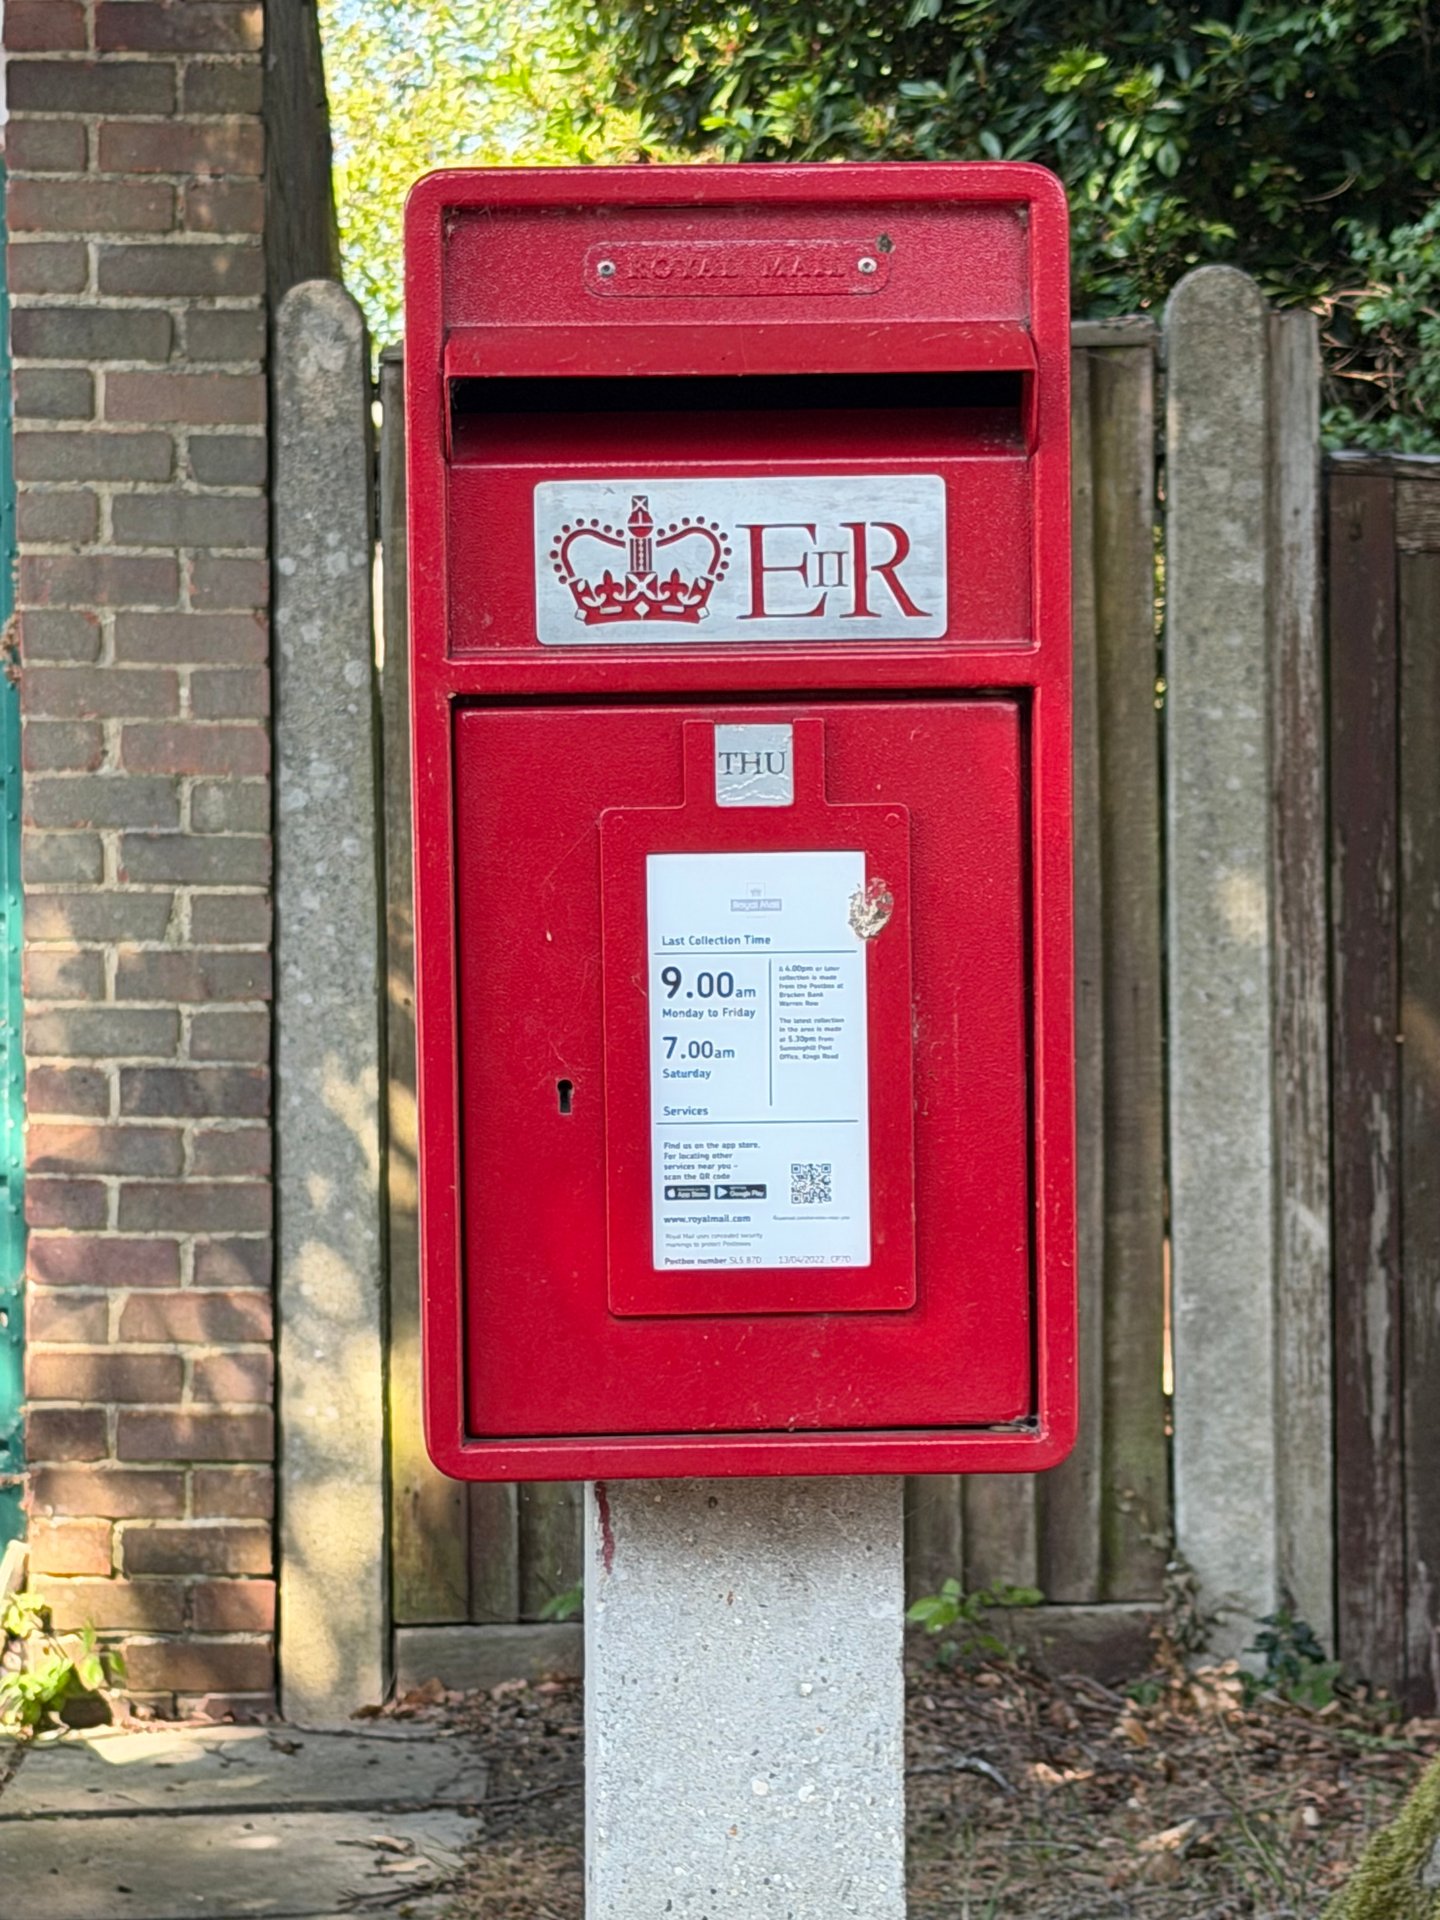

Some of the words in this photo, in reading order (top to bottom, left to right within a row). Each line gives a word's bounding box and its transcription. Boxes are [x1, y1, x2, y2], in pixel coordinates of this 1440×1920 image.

[627, 255, 740, 279] ROYAL
[718, 750, 788, 775] THU
[662, 935, 685, 946] Last
[689, 935, 740, 945] Collection
[744, 934, 771, 944] Time
[662, 1008, 704, 1019] Monday
[708, 1008, 718, 1017] to
[722, 1007, 756, 1019] Friday
[662, 1036, 735, 1059] 7.00am
[662, 1068, 711, 1079] Saturday
[663, 1106, 709, 1116] Services
[679, 1152, 710, 1160] locating
[699, 1172, 710, 1180] QR
[663, 1214, 751, 1224] www.royalmail.com
[664, 1257, 695, 1265] Postbox
